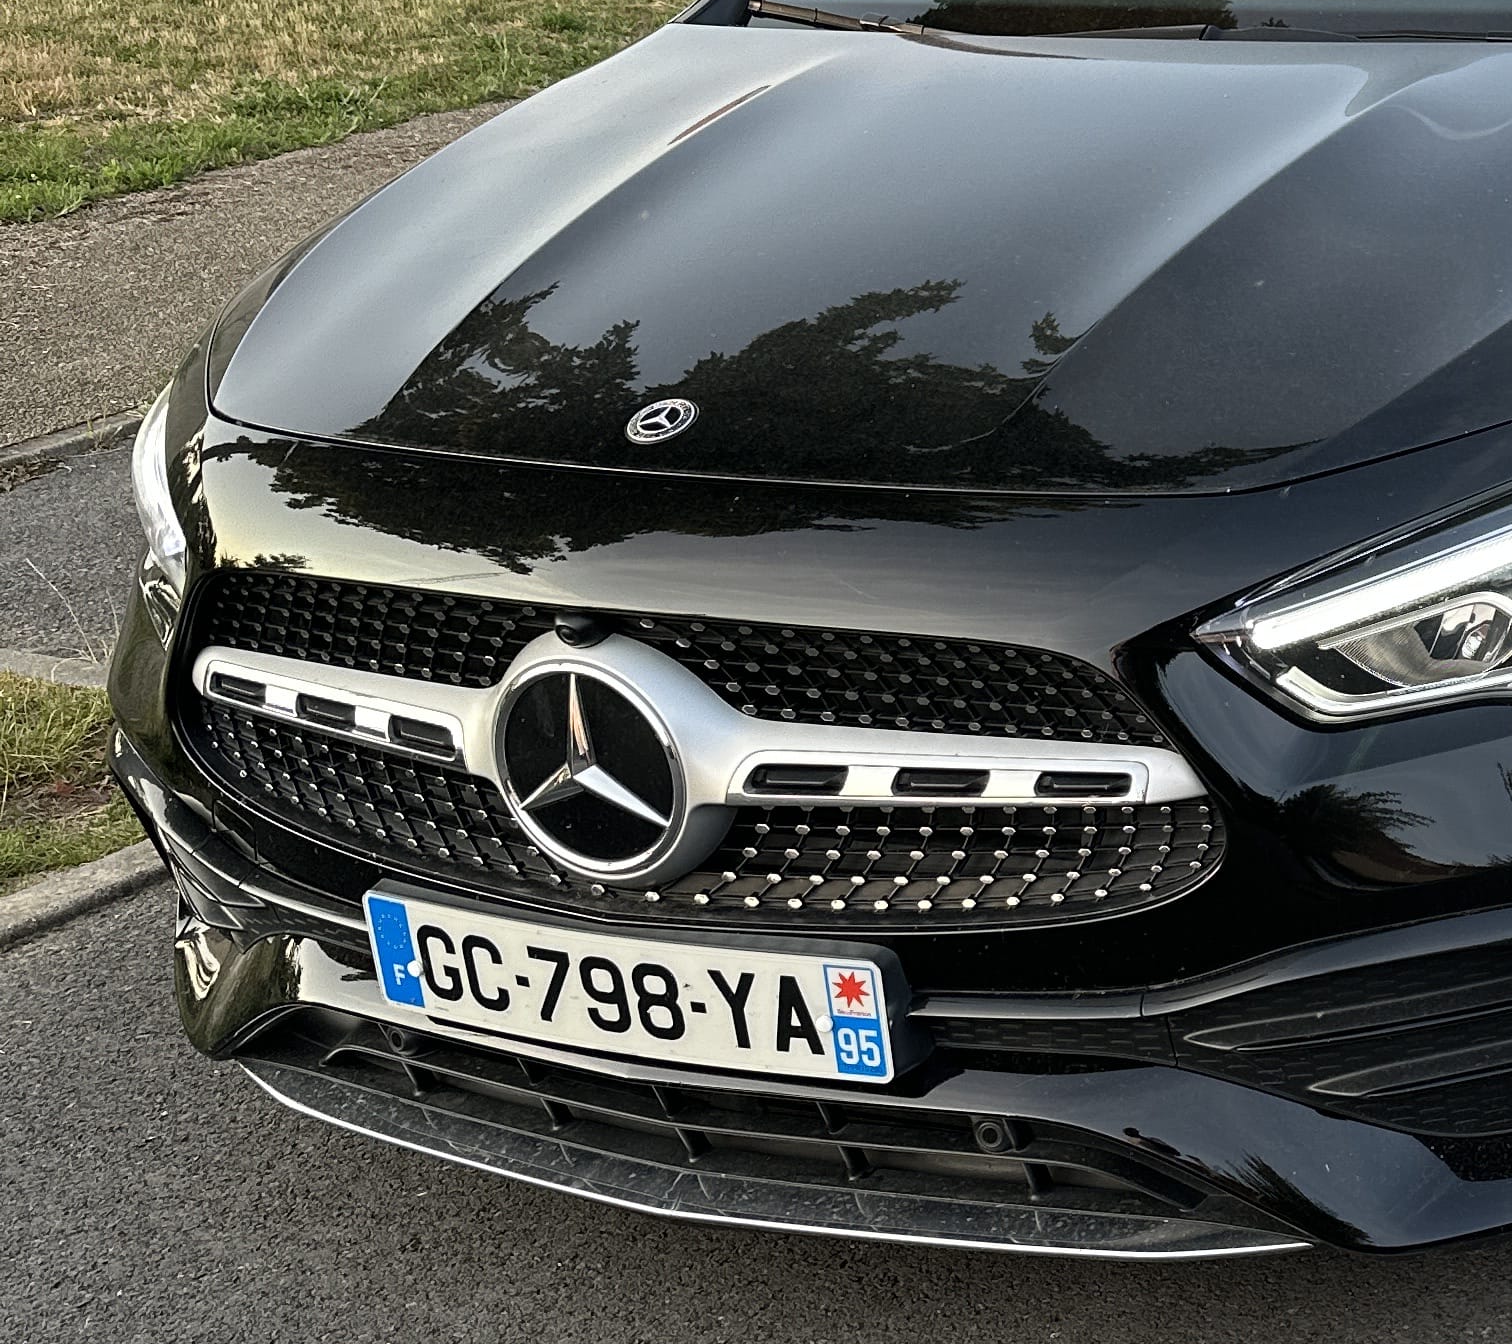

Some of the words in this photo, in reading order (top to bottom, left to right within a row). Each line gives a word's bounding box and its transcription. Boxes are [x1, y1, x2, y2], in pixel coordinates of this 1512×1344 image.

[393, 963, 405, 985] F
[416, 925, 825, 1056] GC-798-YA
[837, 1027, 881, 1068] 95
